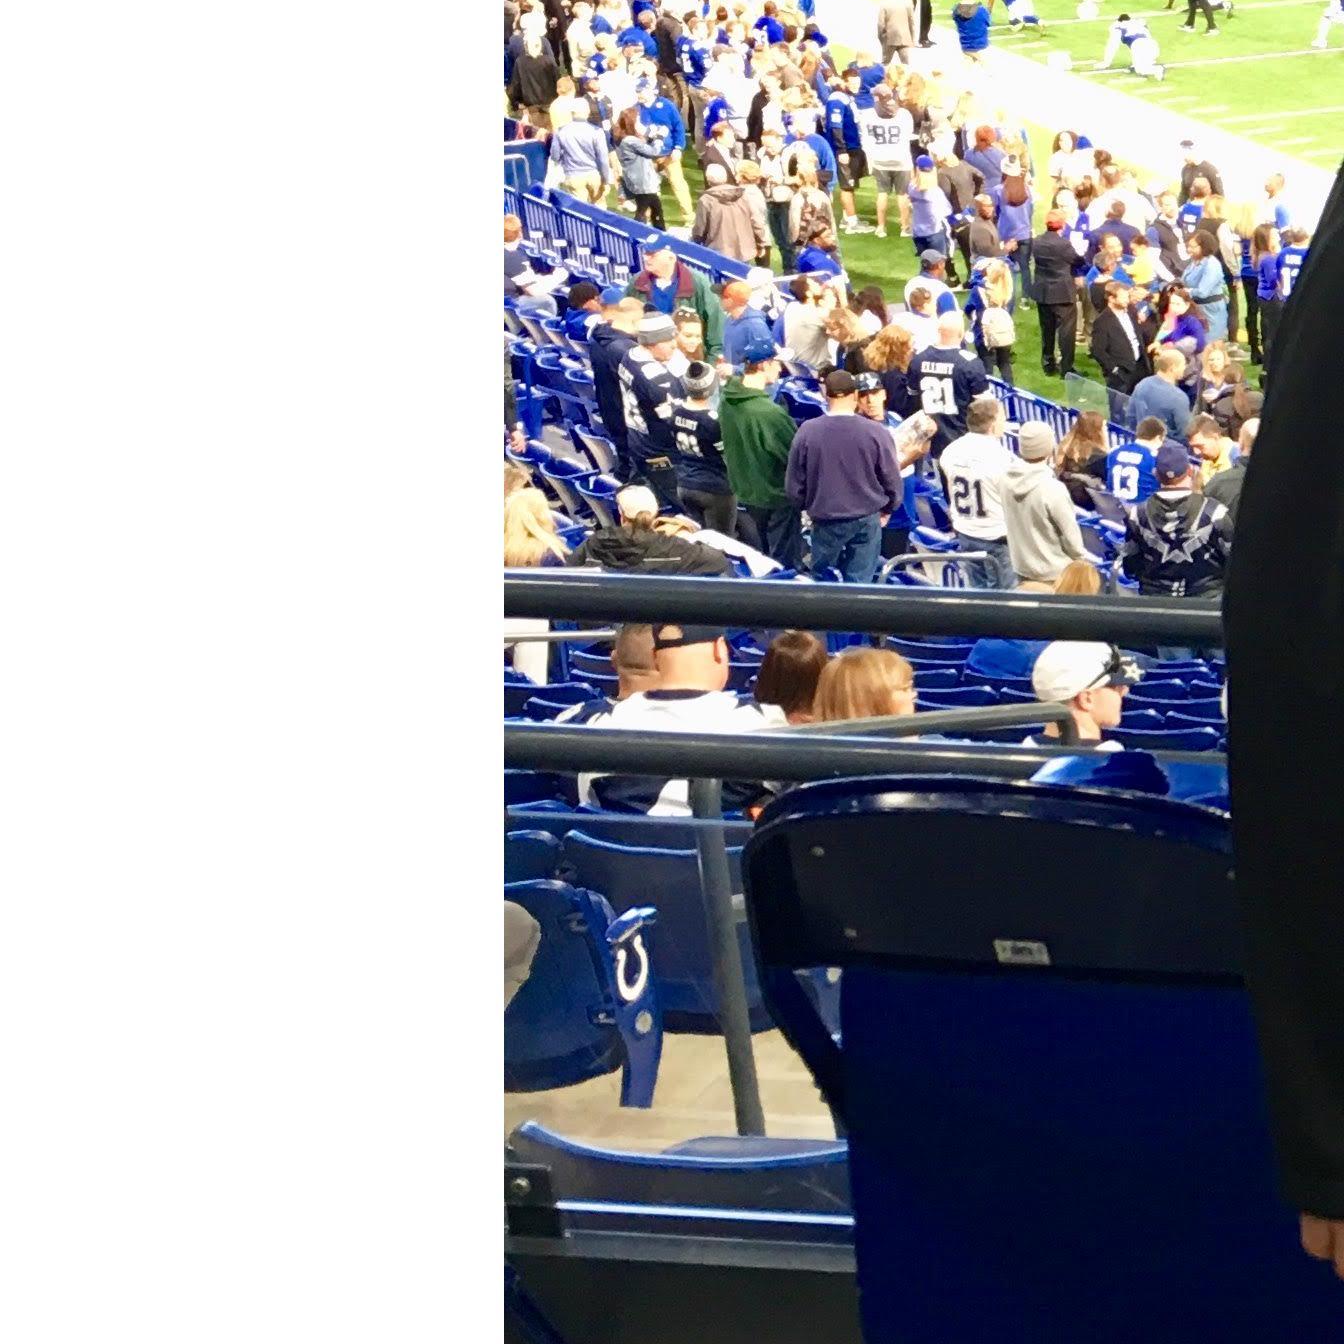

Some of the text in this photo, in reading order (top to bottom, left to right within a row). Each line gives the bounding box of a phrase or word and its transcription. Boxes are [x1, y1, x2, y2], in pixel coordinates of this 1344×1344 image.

[920, 376, 959, 415] 21
[953, 475, 988, 518] 21
[1112, 464, 1140, 500] 13
